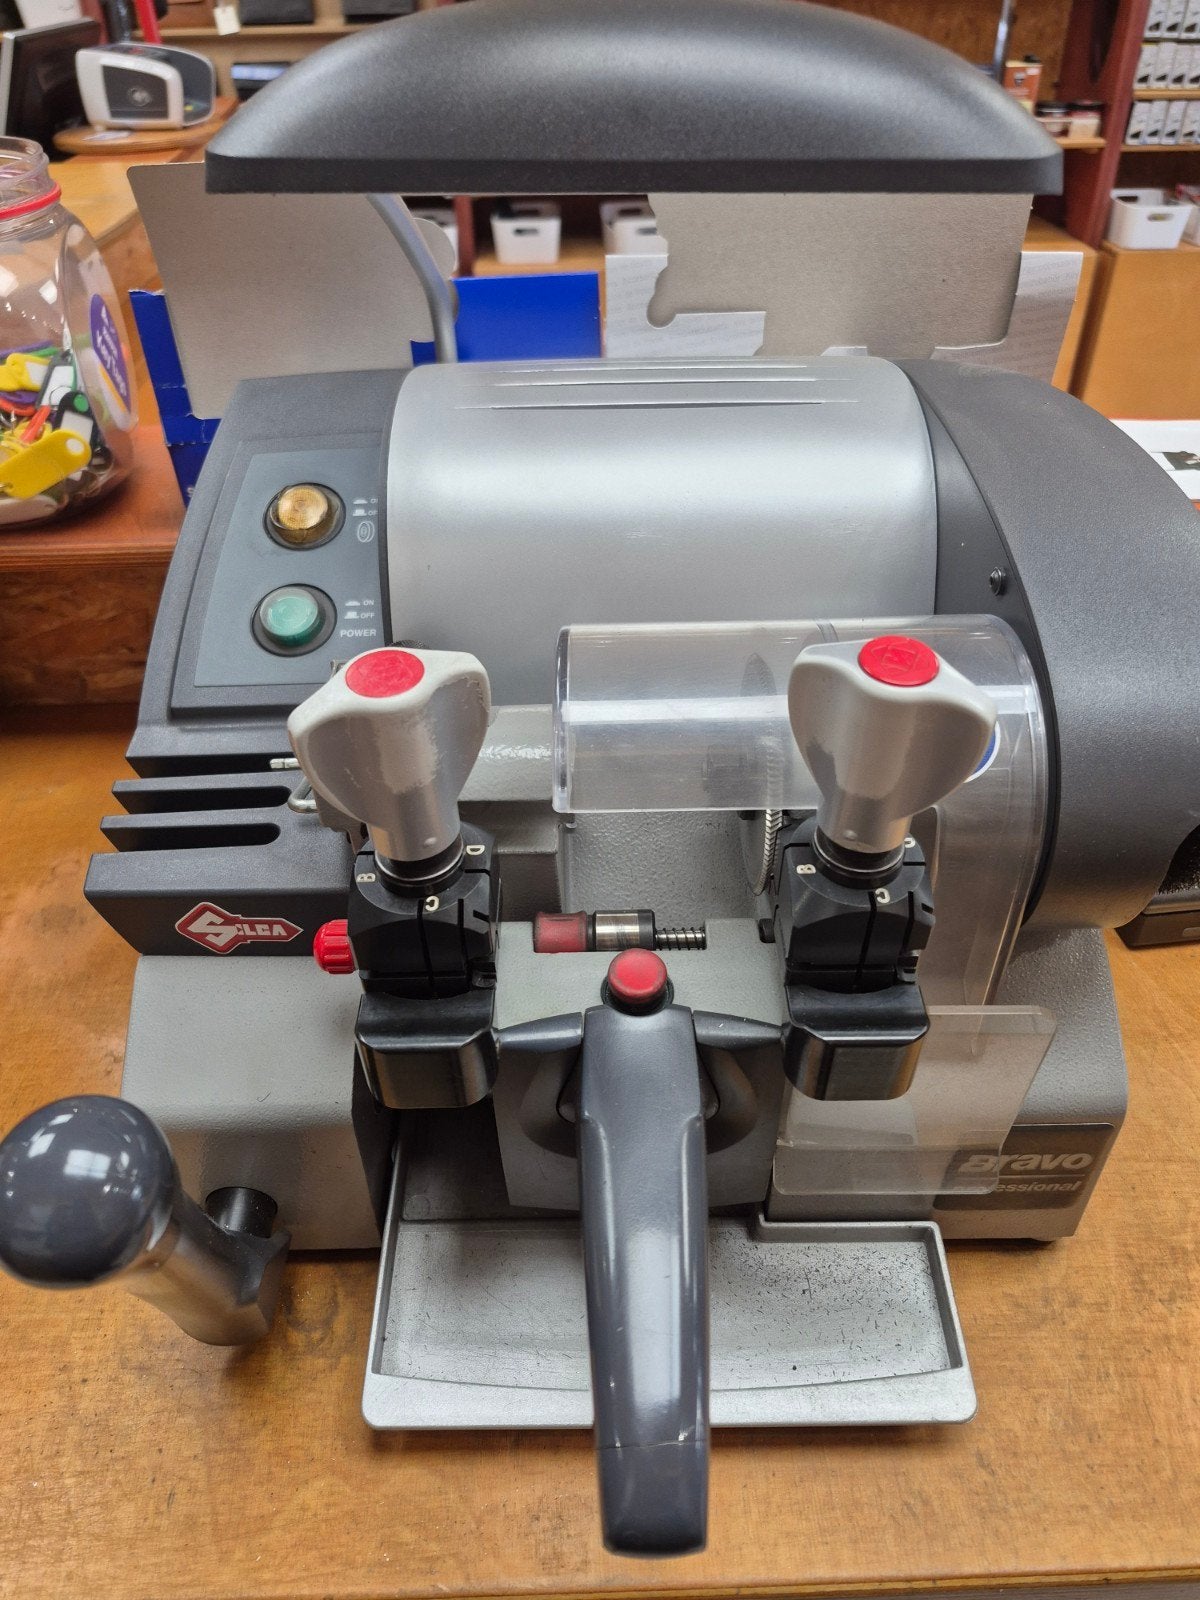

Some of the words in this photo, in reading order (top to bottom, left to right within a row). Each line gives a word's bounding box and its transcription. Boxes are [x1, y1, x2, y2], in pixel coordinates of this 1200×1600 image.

[360, 612, 375, 620] OFF
[340, 629, 377, 638] POWER
[958, 1153, 1094, 1173] Bravo
